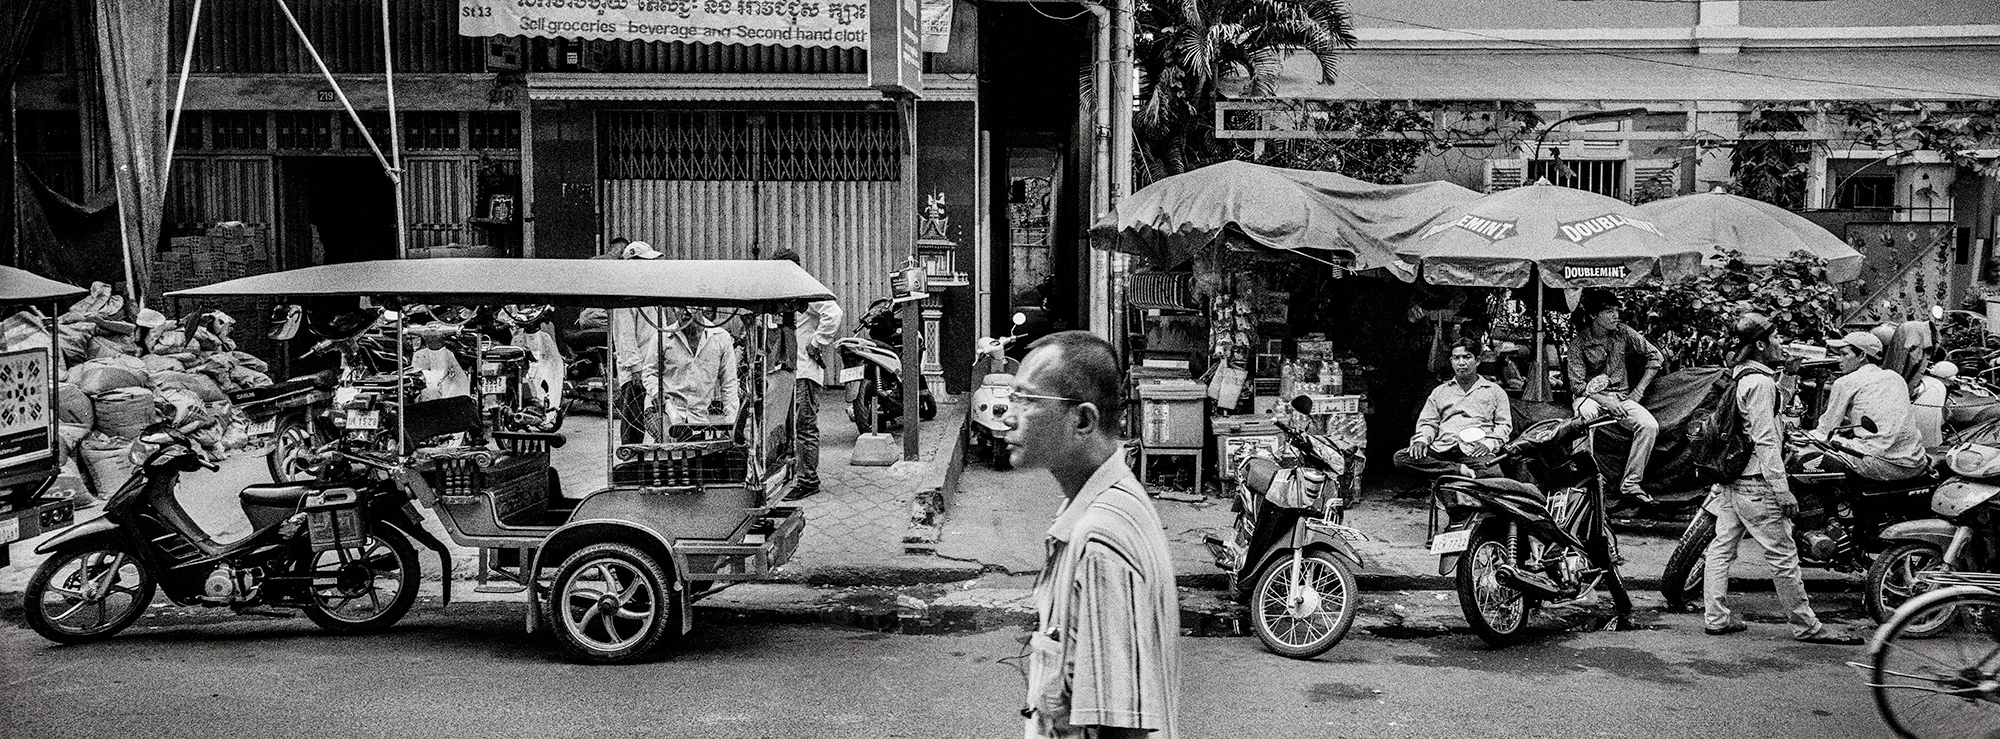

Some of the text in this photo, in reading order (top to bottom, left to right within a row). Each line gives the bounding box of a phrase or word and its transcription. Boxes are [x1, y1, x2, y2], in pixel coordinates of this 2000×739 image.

[519, 16, 545, 31] Sell
[547, 19, 616, 34] groceries
[628, 20, 697, 38] beverage
[736, 25, 791, 40] Second
[796, 27, 832, 41] hand
[319, 91, 334, 101] 219
